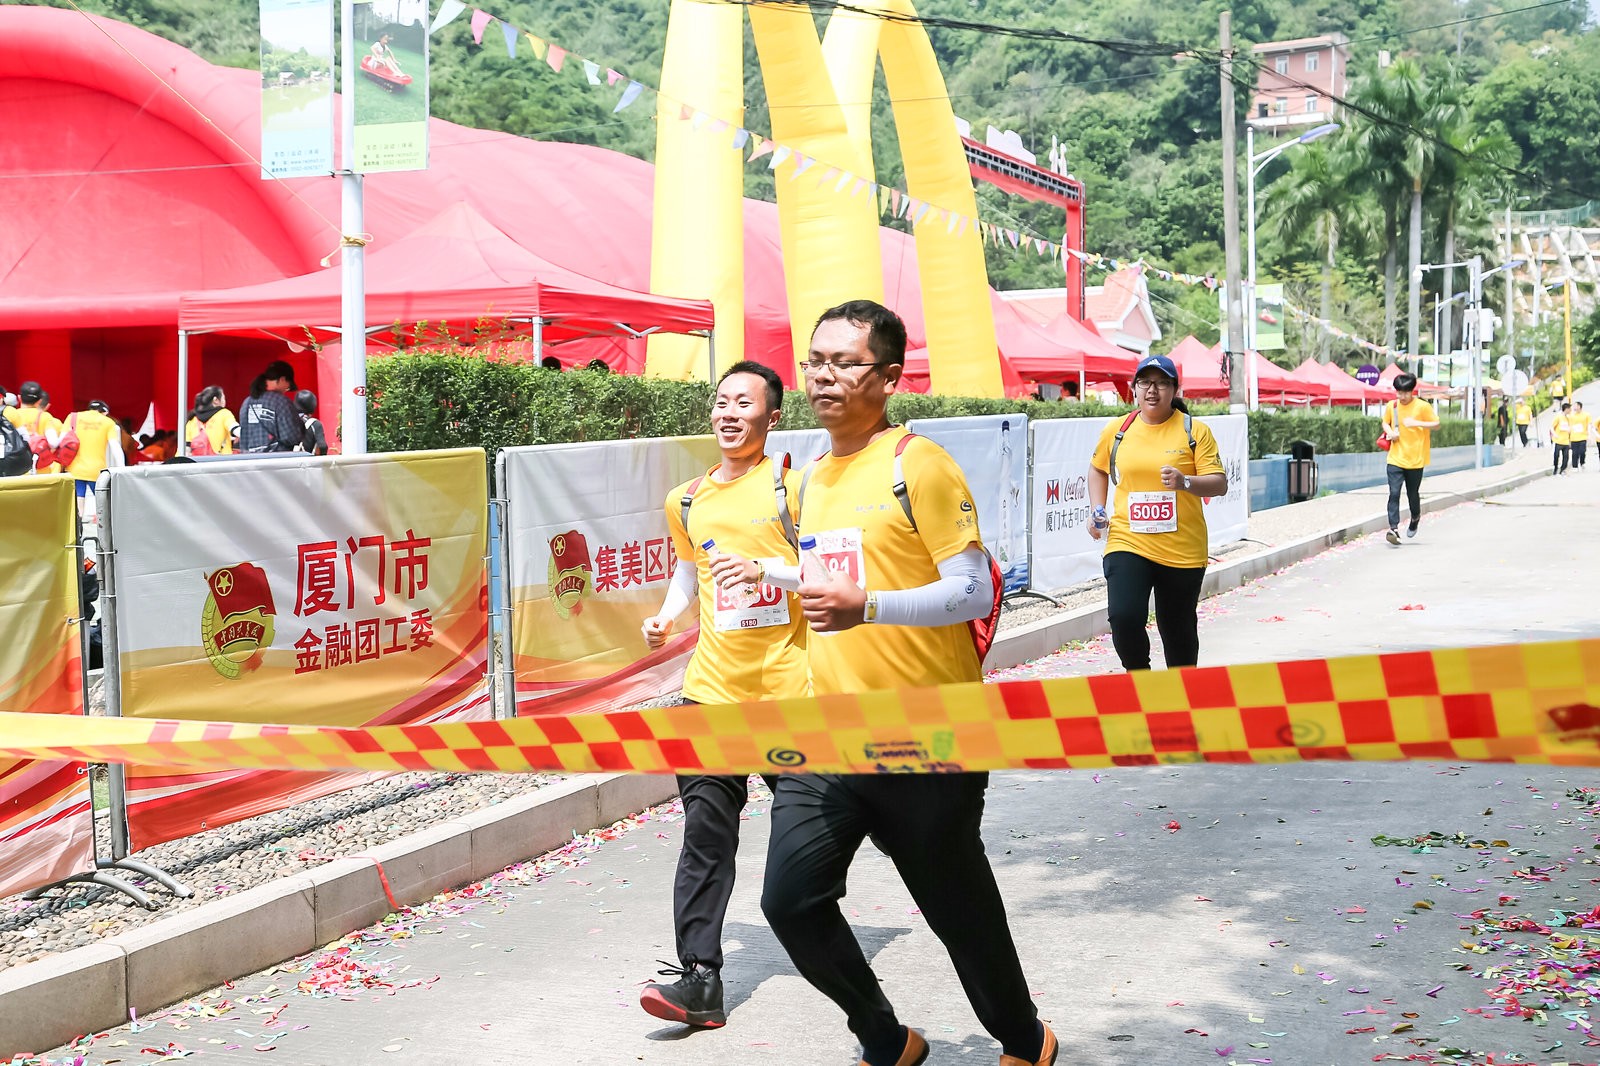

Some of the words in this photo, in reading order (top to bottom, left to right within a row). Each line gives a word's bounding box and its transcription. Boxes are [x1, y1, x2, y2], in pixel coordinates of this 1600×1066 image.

[1133, 504, 1170, 519] 5005
[293, 529, 431, 617] 厦门市
[293, 607, 435, 675] 金融团工委
[741, 619, 757, 628] 5180
